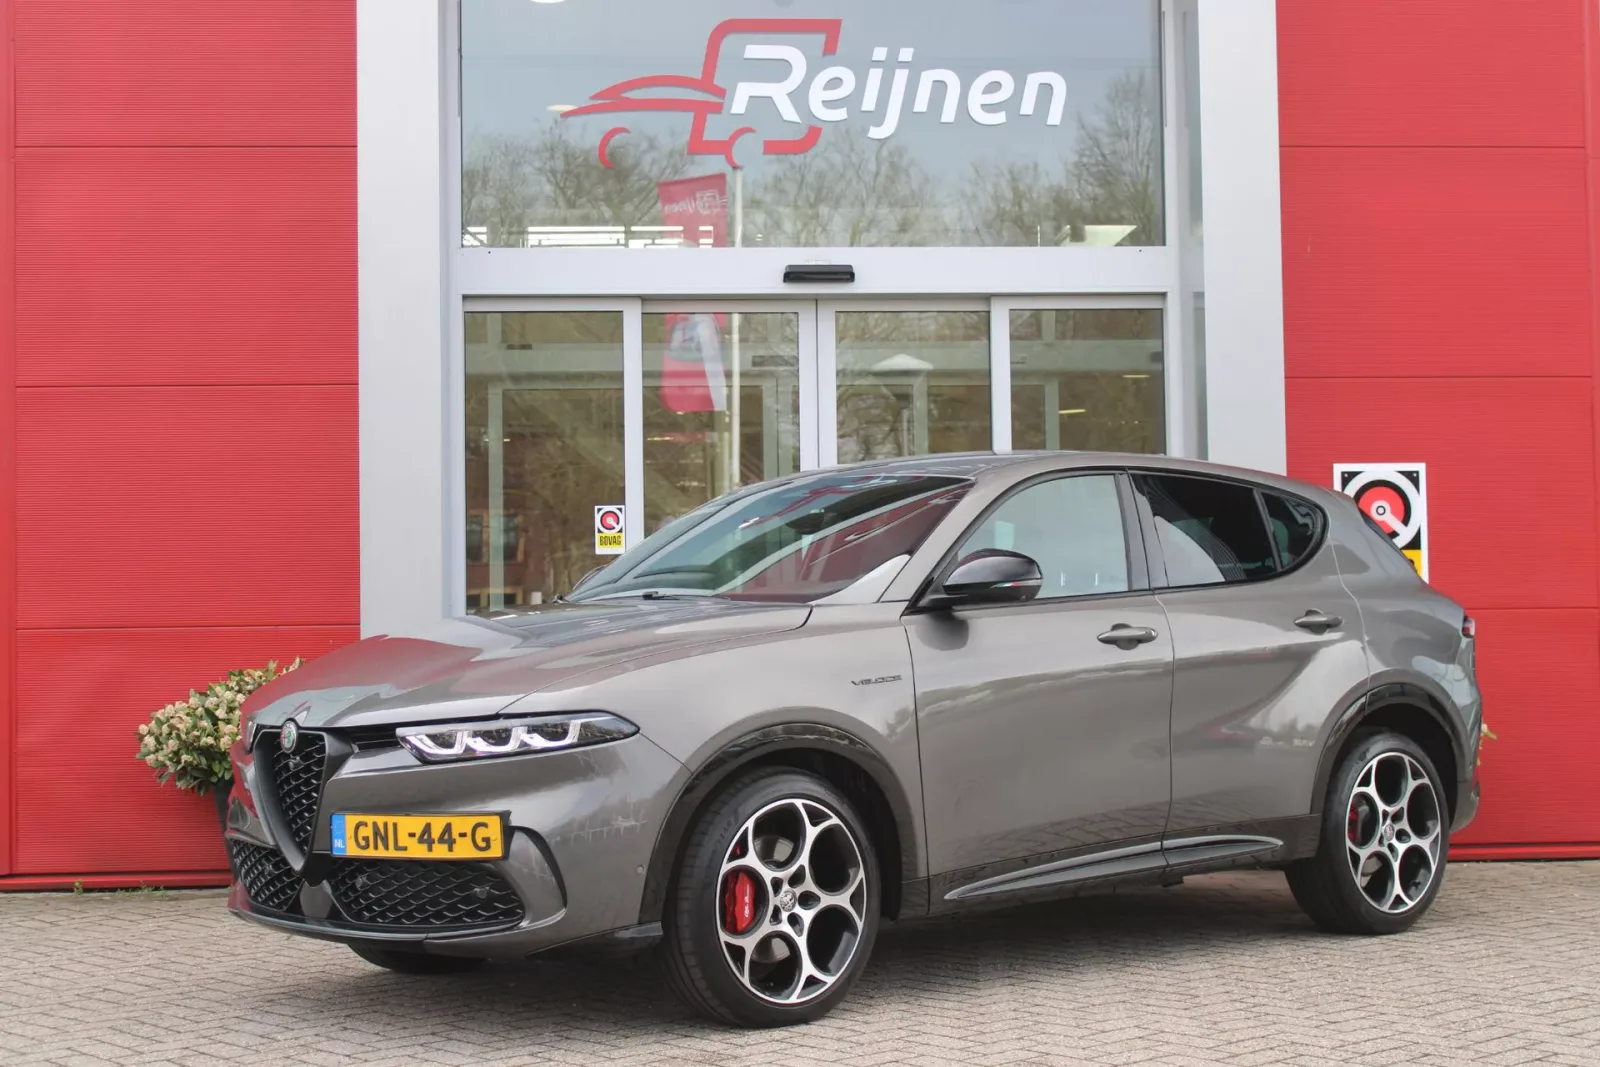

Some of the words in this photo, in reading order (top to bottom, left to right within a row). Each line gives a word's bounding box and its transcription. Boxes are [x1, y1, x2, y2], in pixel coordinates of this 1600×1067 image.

[730, 44, 1067, 139] Reijnen
[599, 535, 621, 546] BOVAG
[334, 838, 345, 848] NL
[353, 821, 492, 852] GNL-44-G
